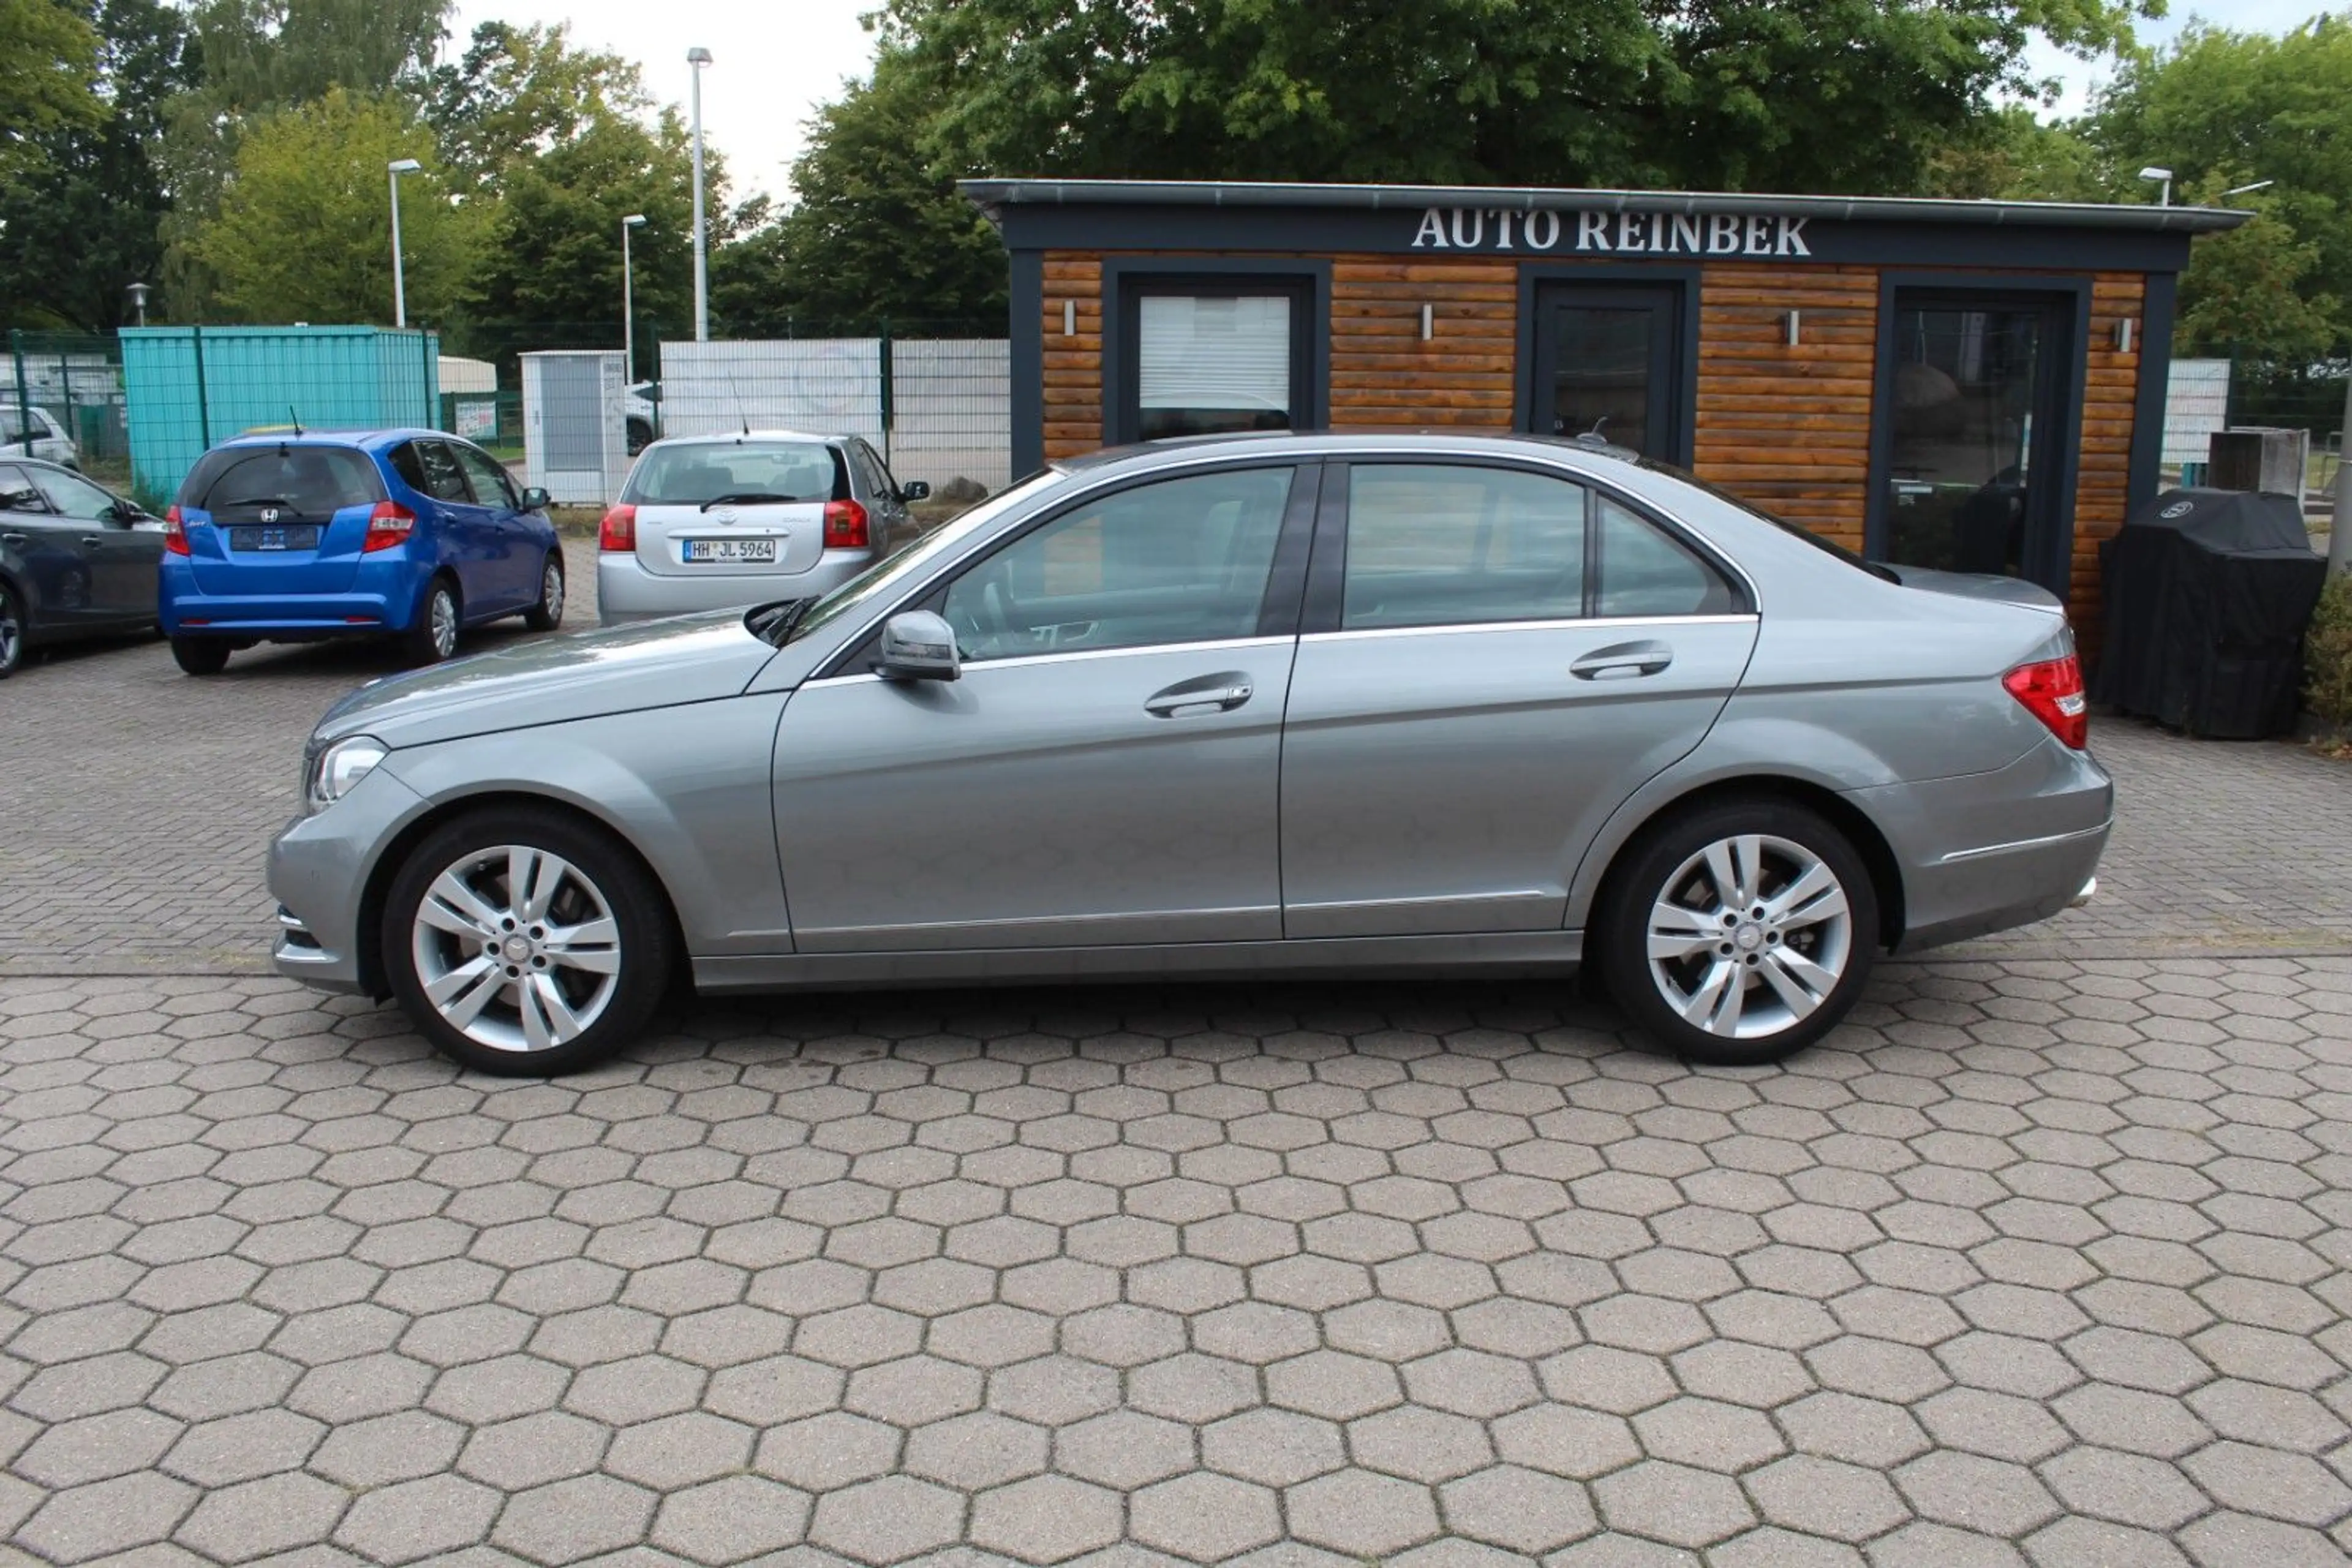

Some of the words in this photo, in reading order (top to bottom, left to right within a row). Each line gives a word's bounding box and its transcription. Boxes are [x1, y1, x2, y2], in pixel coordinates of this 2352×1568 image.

[1411, 207, 1560, 249] AUTO
[1575, 210, 1812, 256] REINBEK
[693, 542, 710, 556] HH
[720, 542, 736, 556] JL
[739, 541, 771, 556] 5964
